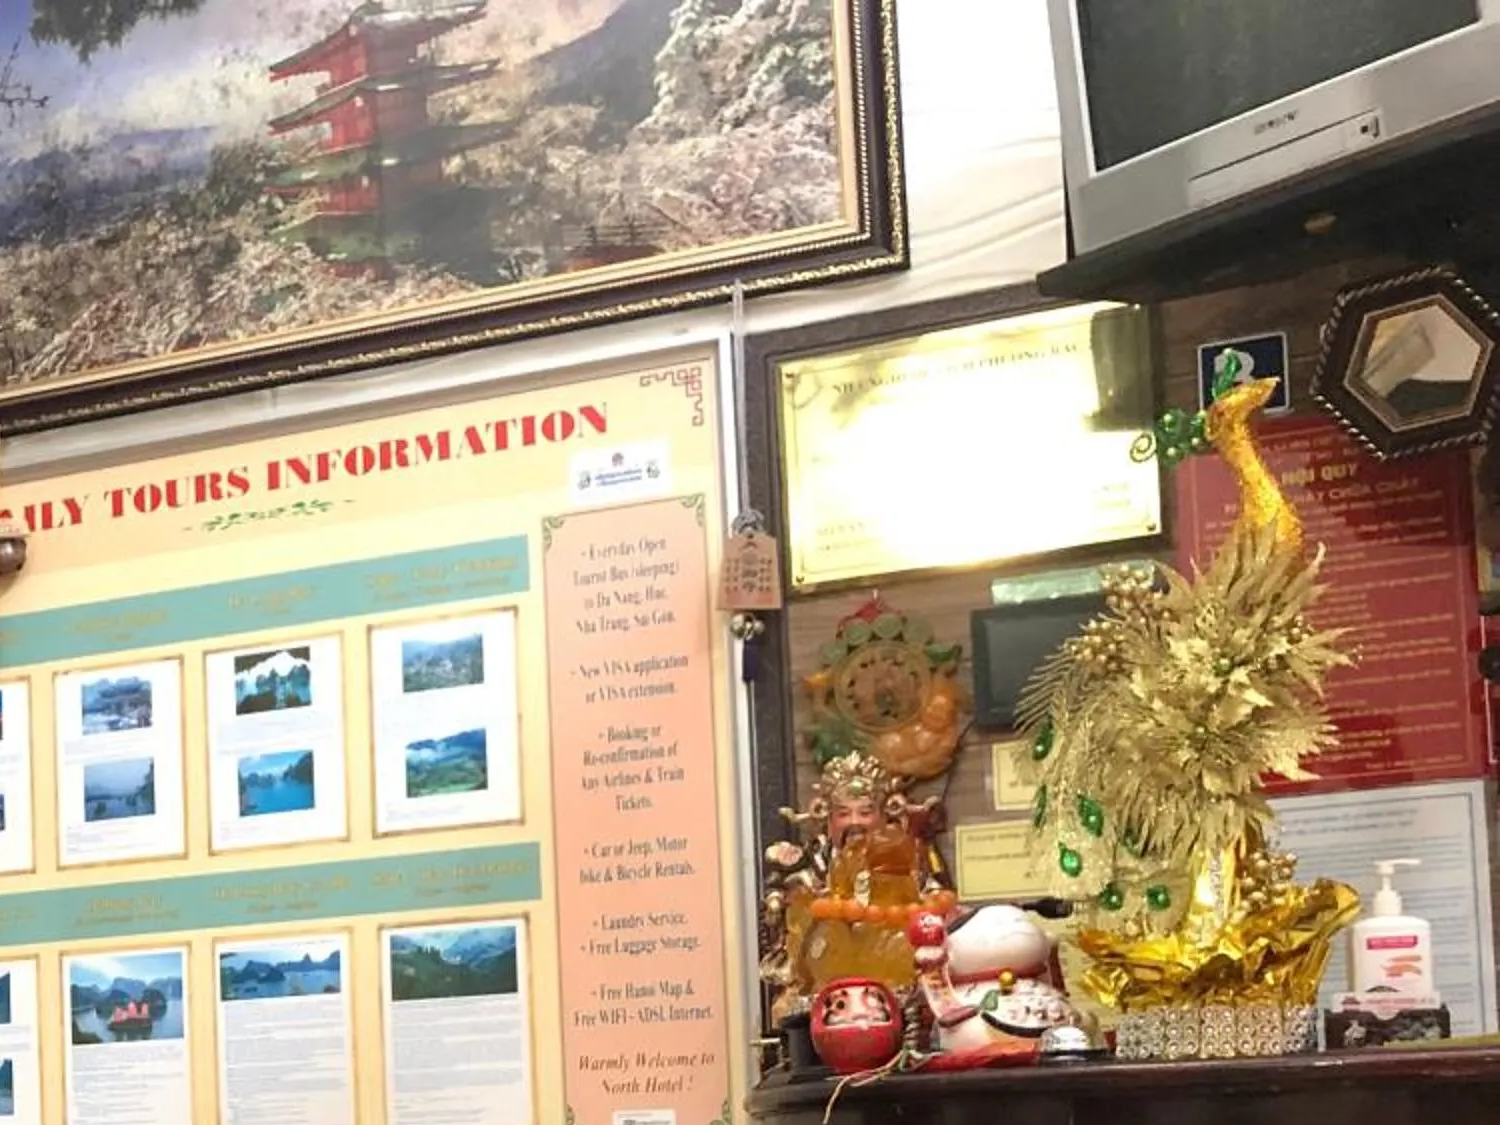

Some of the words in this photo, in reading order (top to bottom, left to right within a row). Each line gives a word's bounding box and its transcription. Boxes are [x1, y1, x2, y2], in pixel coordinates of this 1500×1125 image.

[103, 466, 251, 517] TOURS
[266, 402, 610, 492] INFORMATION
[603, 658, 632, 676] VISA
[633, 655, 689, 678] application
[607, 724, 649, 744] Booking
[656, 765, 685, 783] Train
[591, 841, 611, 859] Car
[655, 834, 688, 852] Motor
[603, 865, 613, 883] &
[617, 862, 652, 883] Bicycle
[601, 912, 645, 932] Laundry
[589, 937, 612, 955] Free
[614, 935, 658, 955] Luggage
[600, 983, 622, 1001] Free
[625, 981, 655, 999] Hanoi
[659, 979, 683, 999] Map
[685, 978, 696, 996] &
[574, 1010, 597, 1027] Free
[579, 1053, 630, 1074] Warmly
[635, 1050, 698, 1069] Welcome
[700, 1052, 716, 1066] to
[602, 1075, 640, 1095] North
[645, 1074, 684, 1093] Hotel
